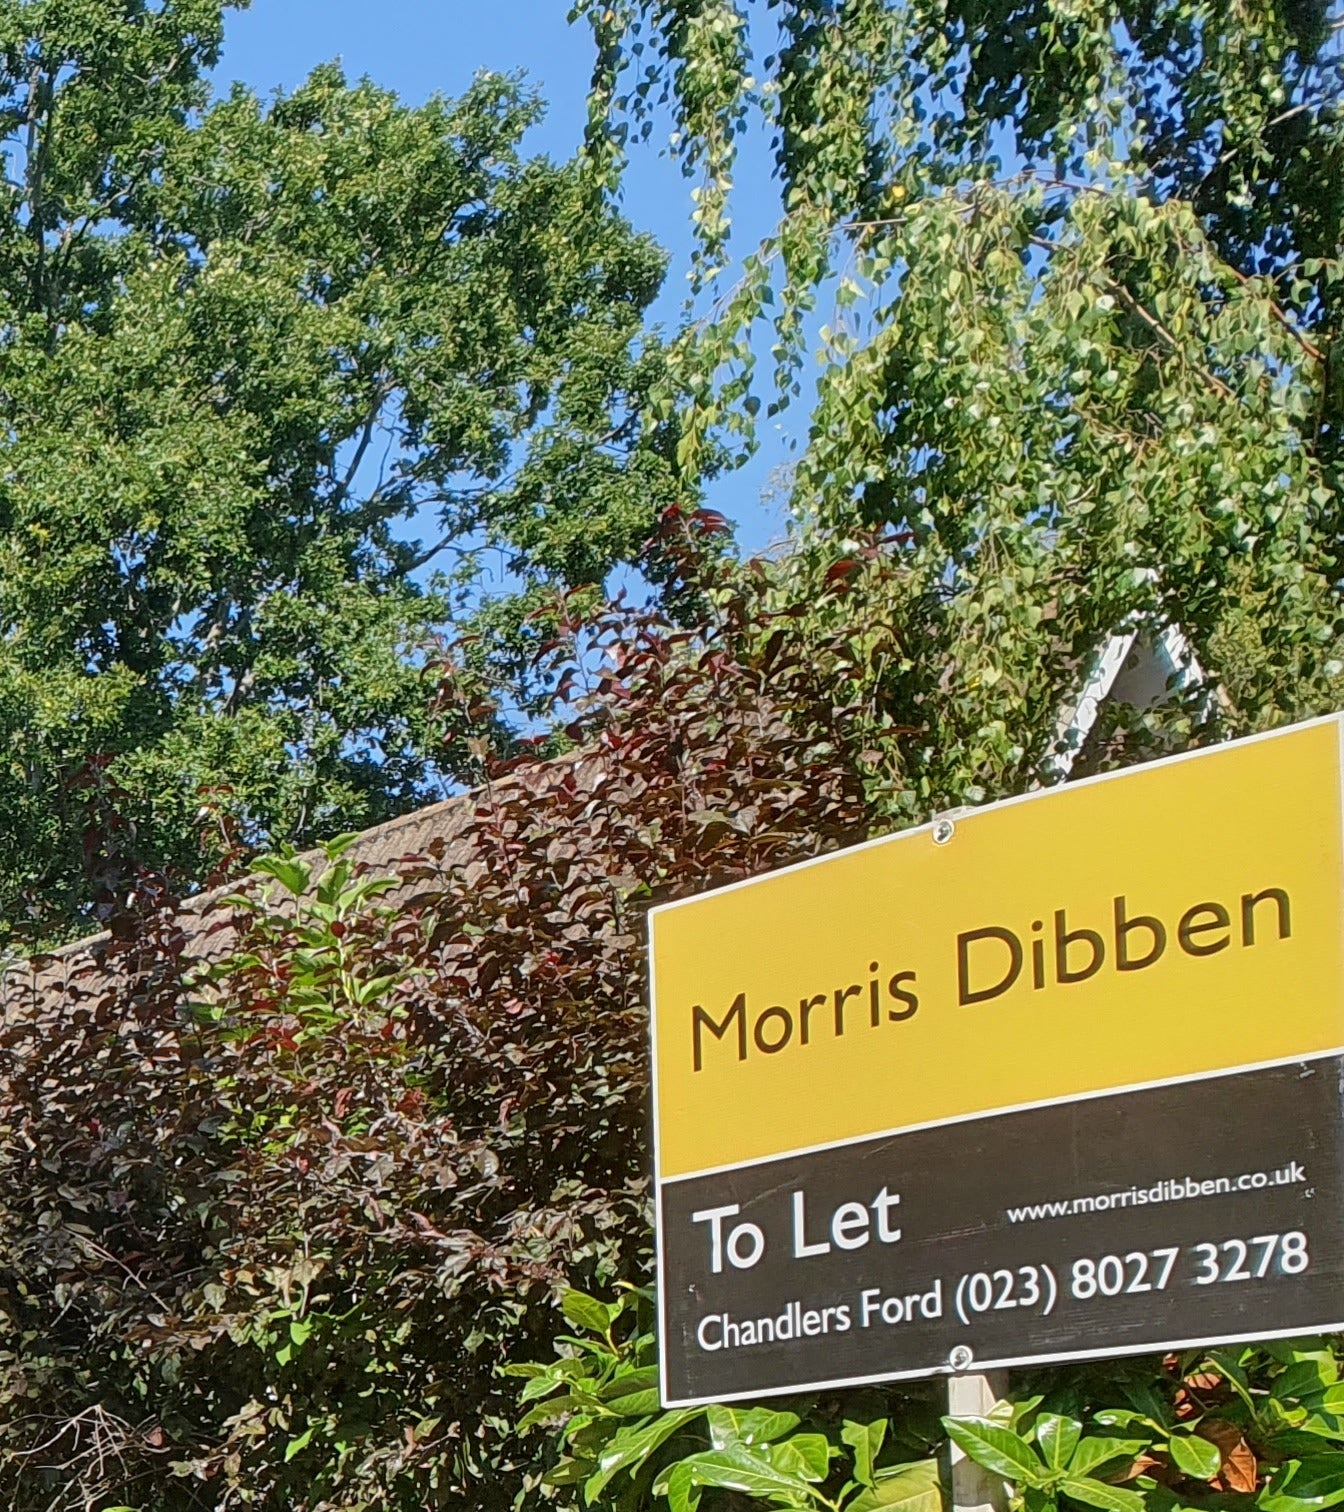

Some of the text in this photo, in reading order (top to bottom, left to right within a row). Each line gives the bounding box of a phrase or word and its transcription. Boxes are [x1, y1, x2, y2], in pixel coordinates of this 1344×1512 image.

[691, 887, 1292, 1073] Morris Dibben
[692, 1187, 902, 1274] To Let
[1006, 1160, 1307, 1224] www.morrisdibben.co.uk
[697, 1231, 1309, 1351] Chandlers Ford (023) 8027 3278
